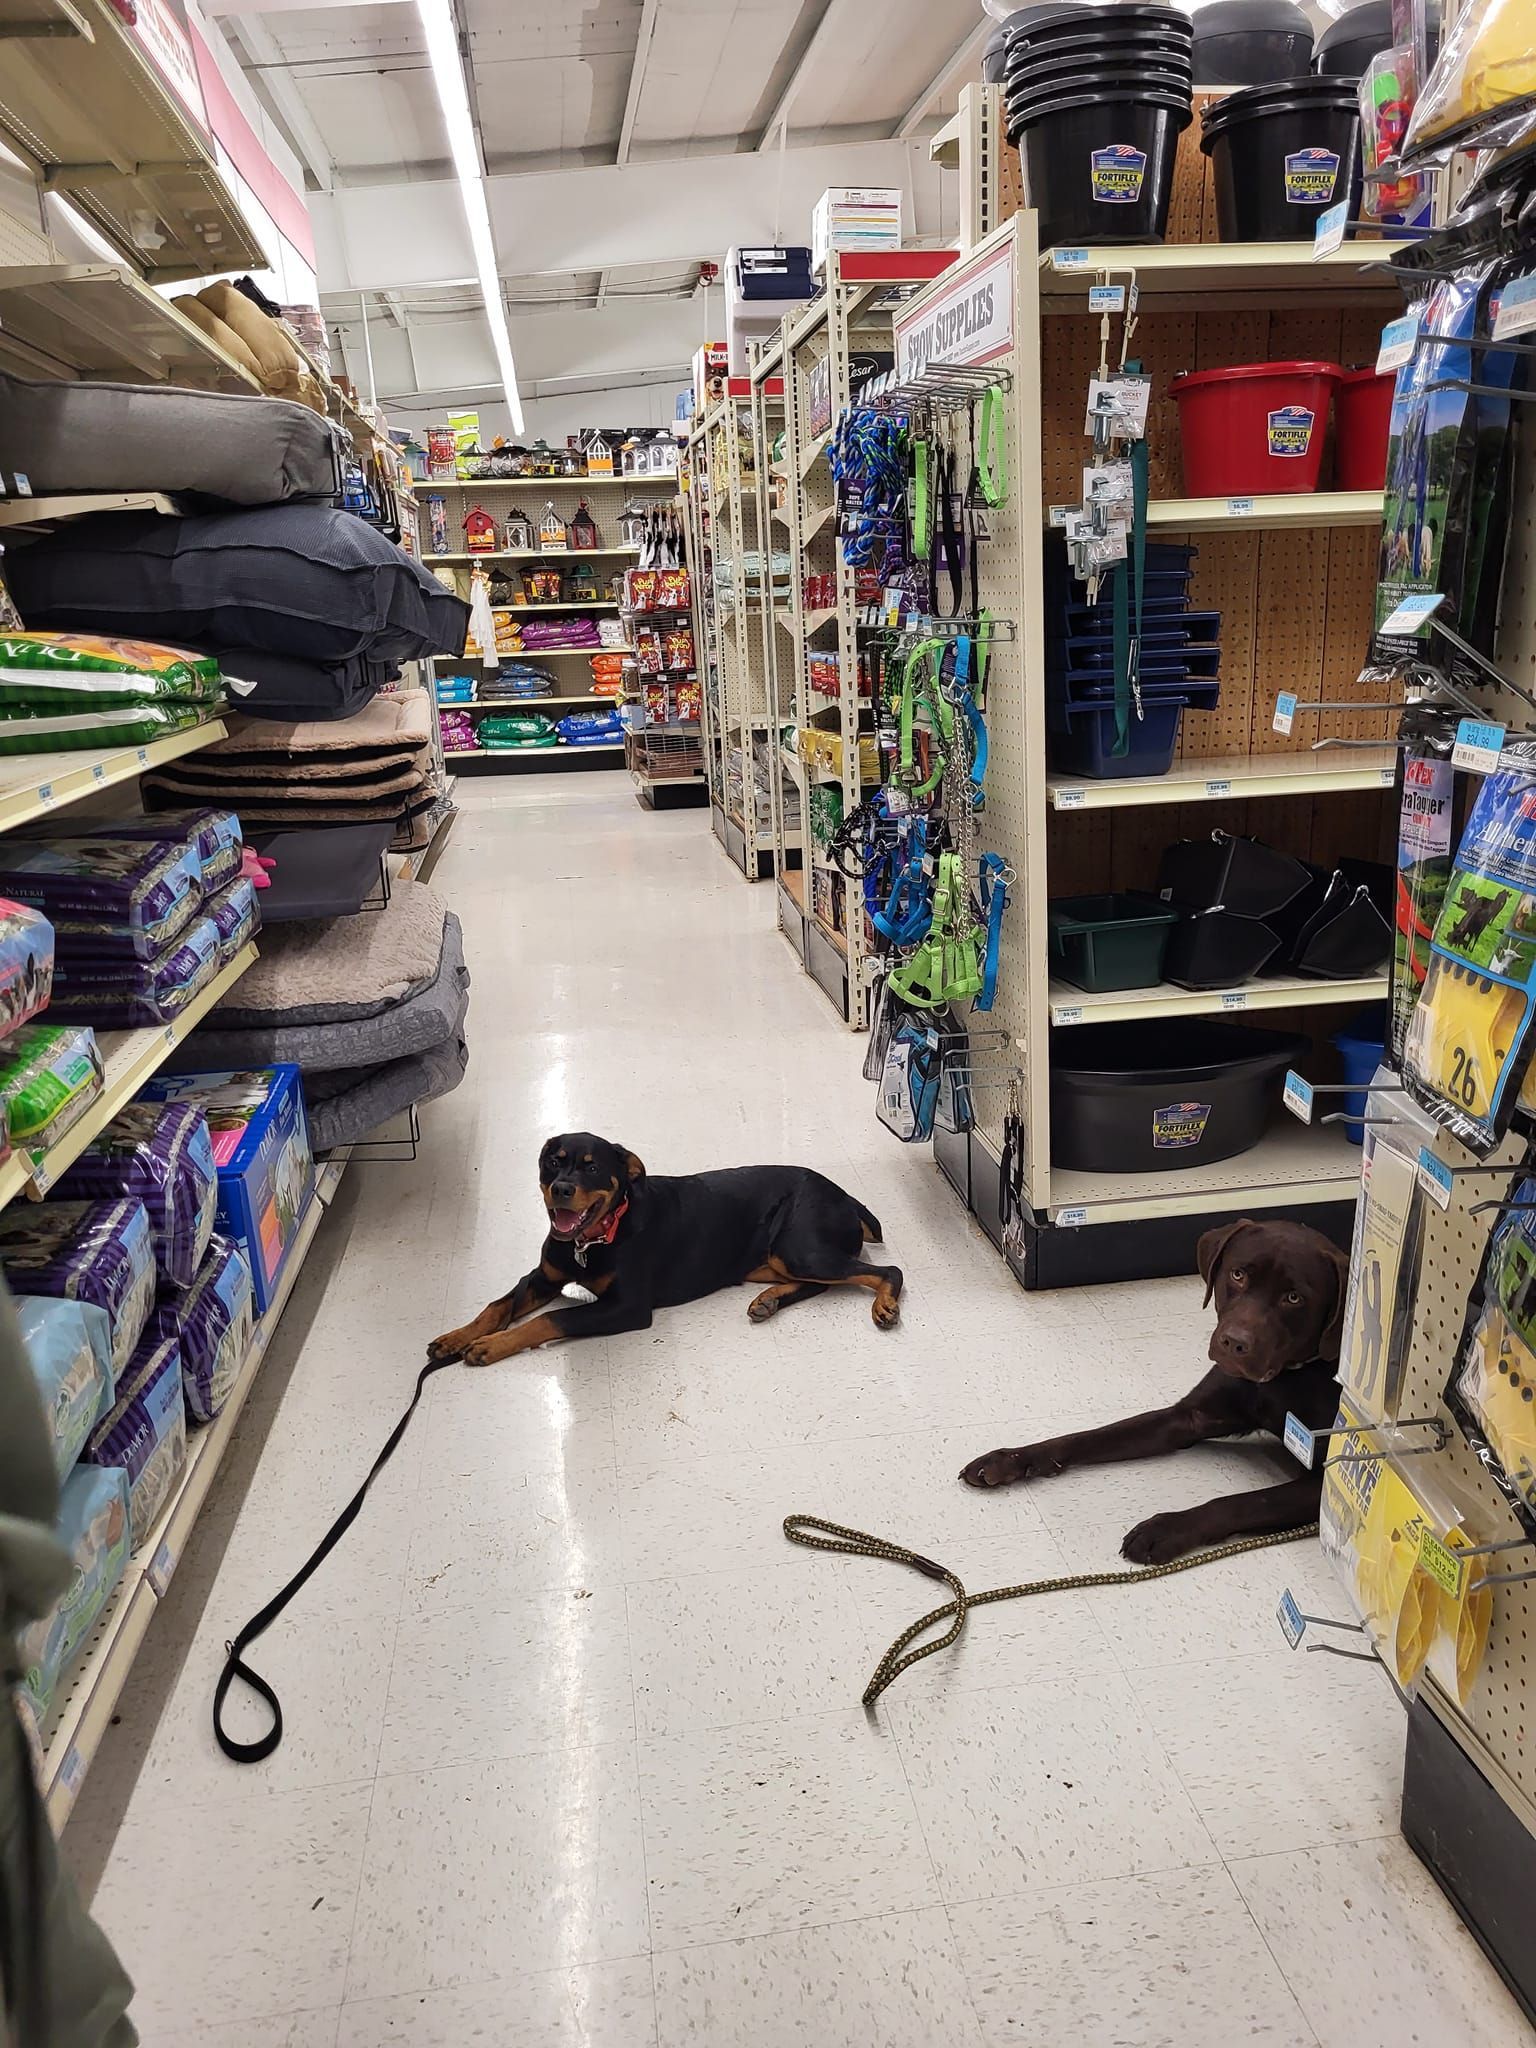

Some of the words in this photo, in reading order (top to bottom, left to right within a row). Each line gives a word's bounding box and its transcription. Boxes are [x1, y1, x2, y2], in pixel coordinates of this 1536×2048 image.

[1097, 173, 1138, 182] FORTIFLEX
[1291, 176, 1331, 184] FORTIFLEX
[908, 323, 935, 361] SHOW
[935, 283, 994, 355] SUPPLIES
[710, 352, 728, 362] MILK-
[849, 364, 874, 380] Cesar
[1273, 431, 1307, 439] FORTIFLEX
[6, 887, 46, 897] NATURAL
[1448, 1046, 1476, 1107] 26
[1158, 1122, 1200, 1132] FORTIFLEX
[1410, 1512, 1424, 1531] Z
[1423, 1532, 1457, 1571] CLEARANCE
